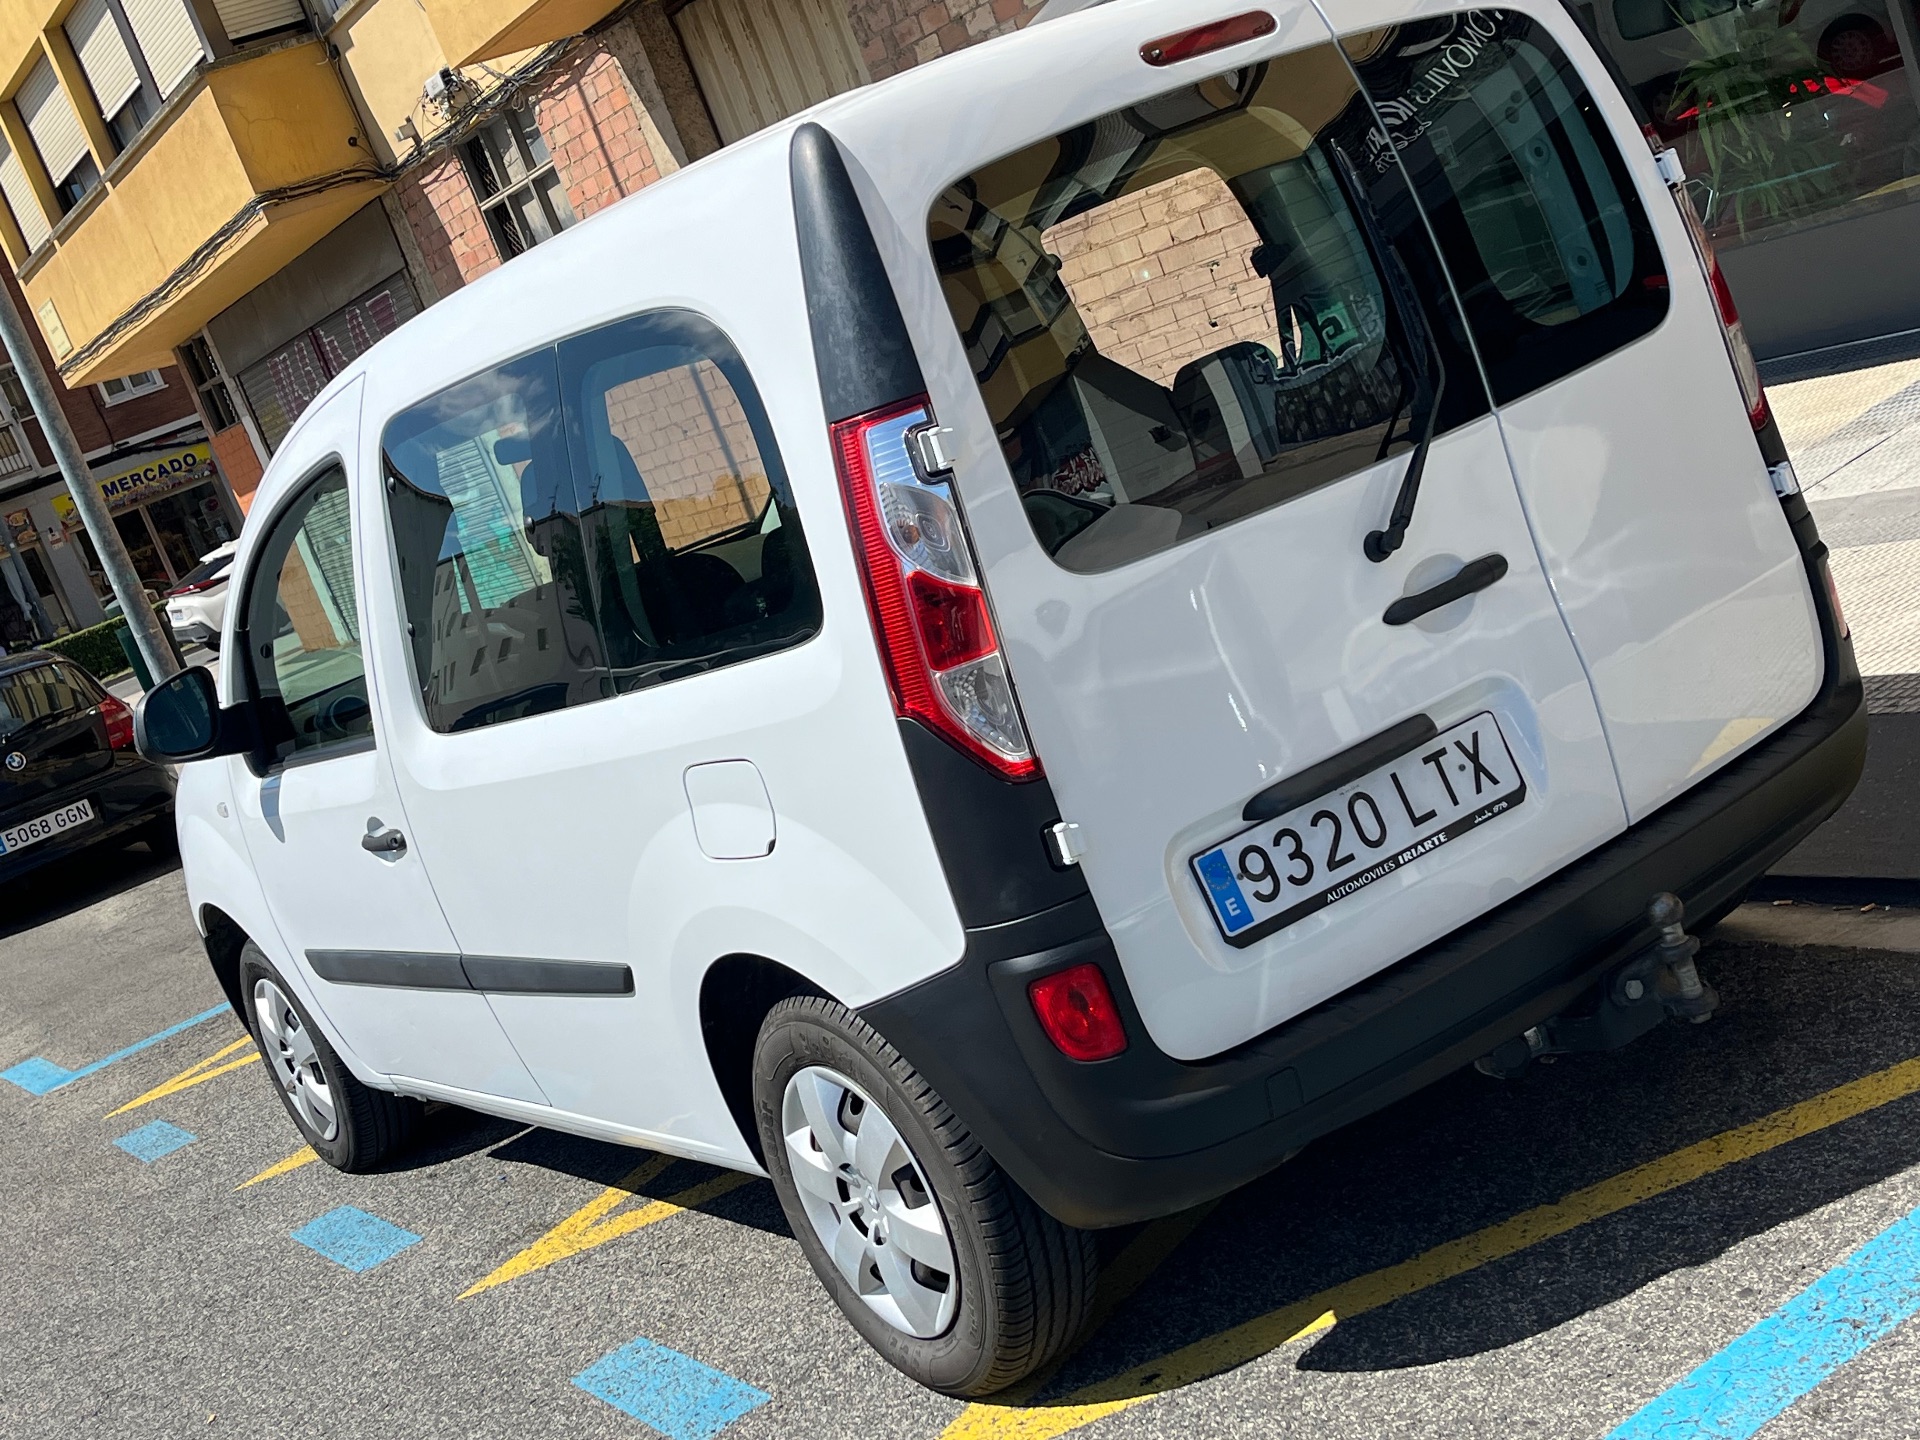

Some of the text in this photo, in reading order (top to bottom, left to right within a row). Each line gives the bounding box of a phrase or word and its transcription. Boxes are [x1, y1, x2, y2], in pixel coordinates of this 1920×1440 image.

[101, 452, 198, 499] MERCADO
[5, 802, 91, 849] 5068 GGN
[1238, 730, 1501, 904] 9320 LTX
[1397, 831, 1449, 866] IRIARTE
[1224, 897, 1242, 917] E
